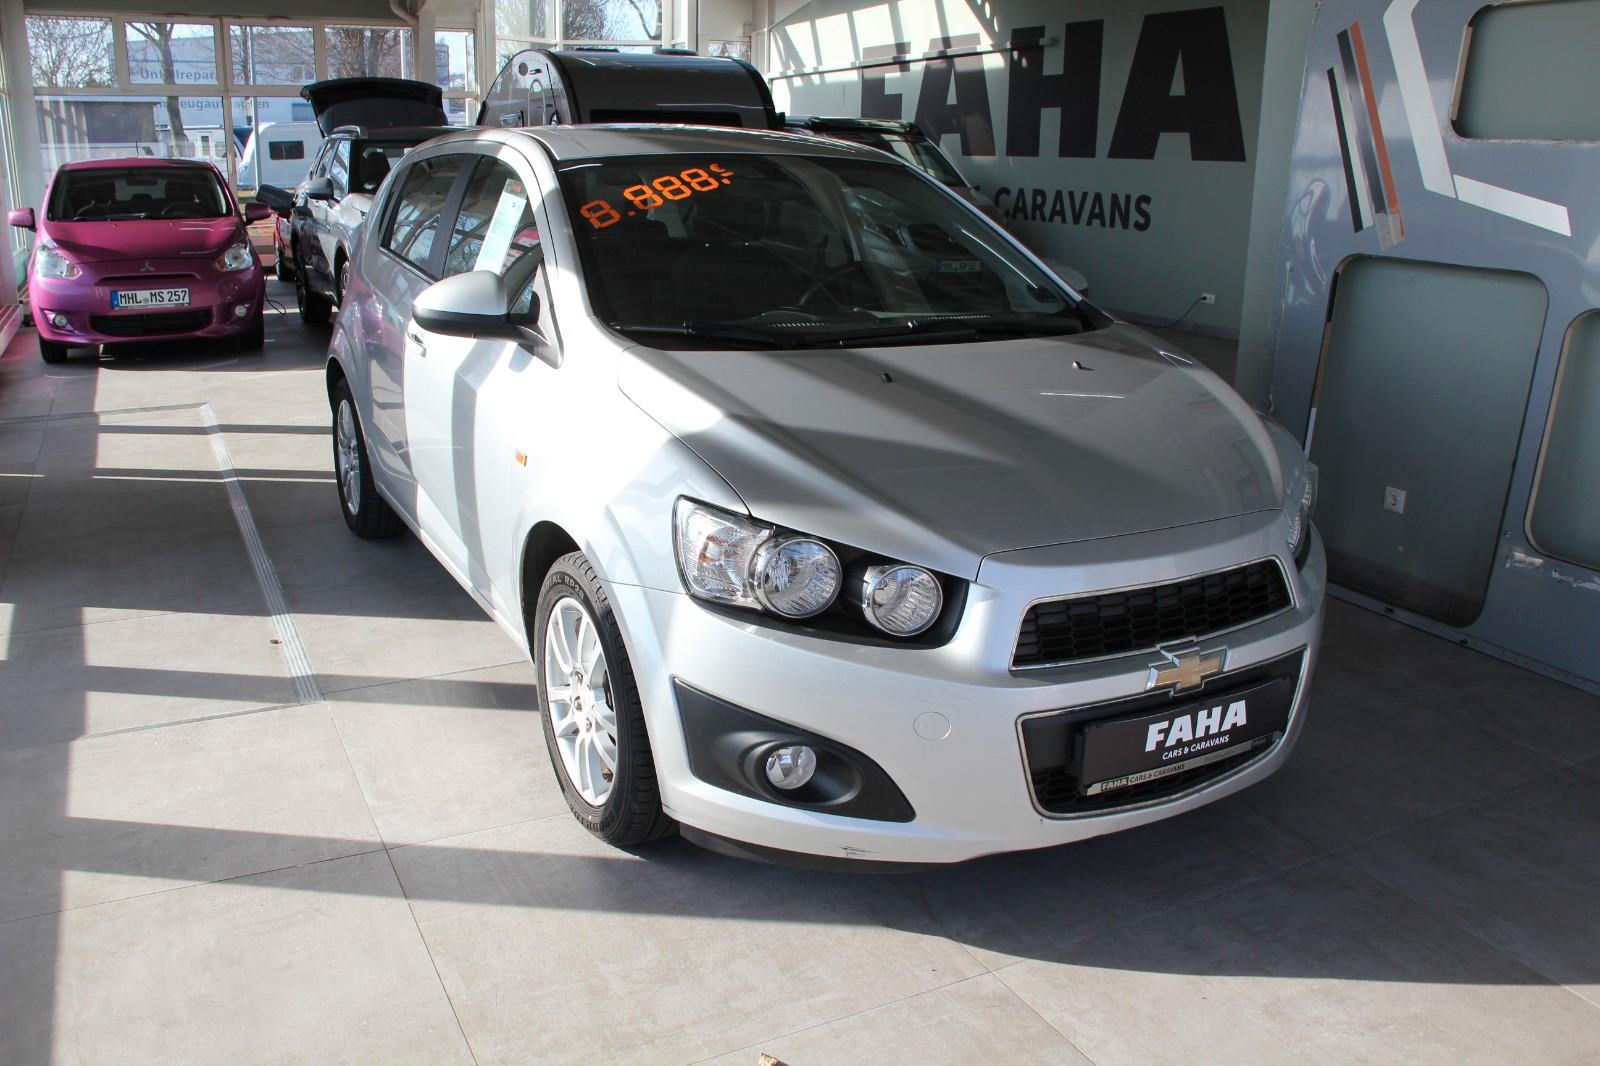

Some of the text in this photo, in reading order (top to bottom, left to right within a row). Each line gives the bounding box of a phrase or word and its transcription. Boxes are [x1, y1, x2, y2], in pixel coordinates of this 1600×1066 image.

[861, 6, 1247, 162] FAHA
[993, 185, 1153, 231] CARAVANS
[119, 290, 187, 305] MHL MS 257
[1144, 699, 1247, 752] FAHA
[1162, 735, 1230, 761] CARS & CARAVANS
[1102, 778, 1128, 790] FAHA
[1129, 774, 1147, 784] CARS
[1154, 763, 1185, 777] CARAVANS
